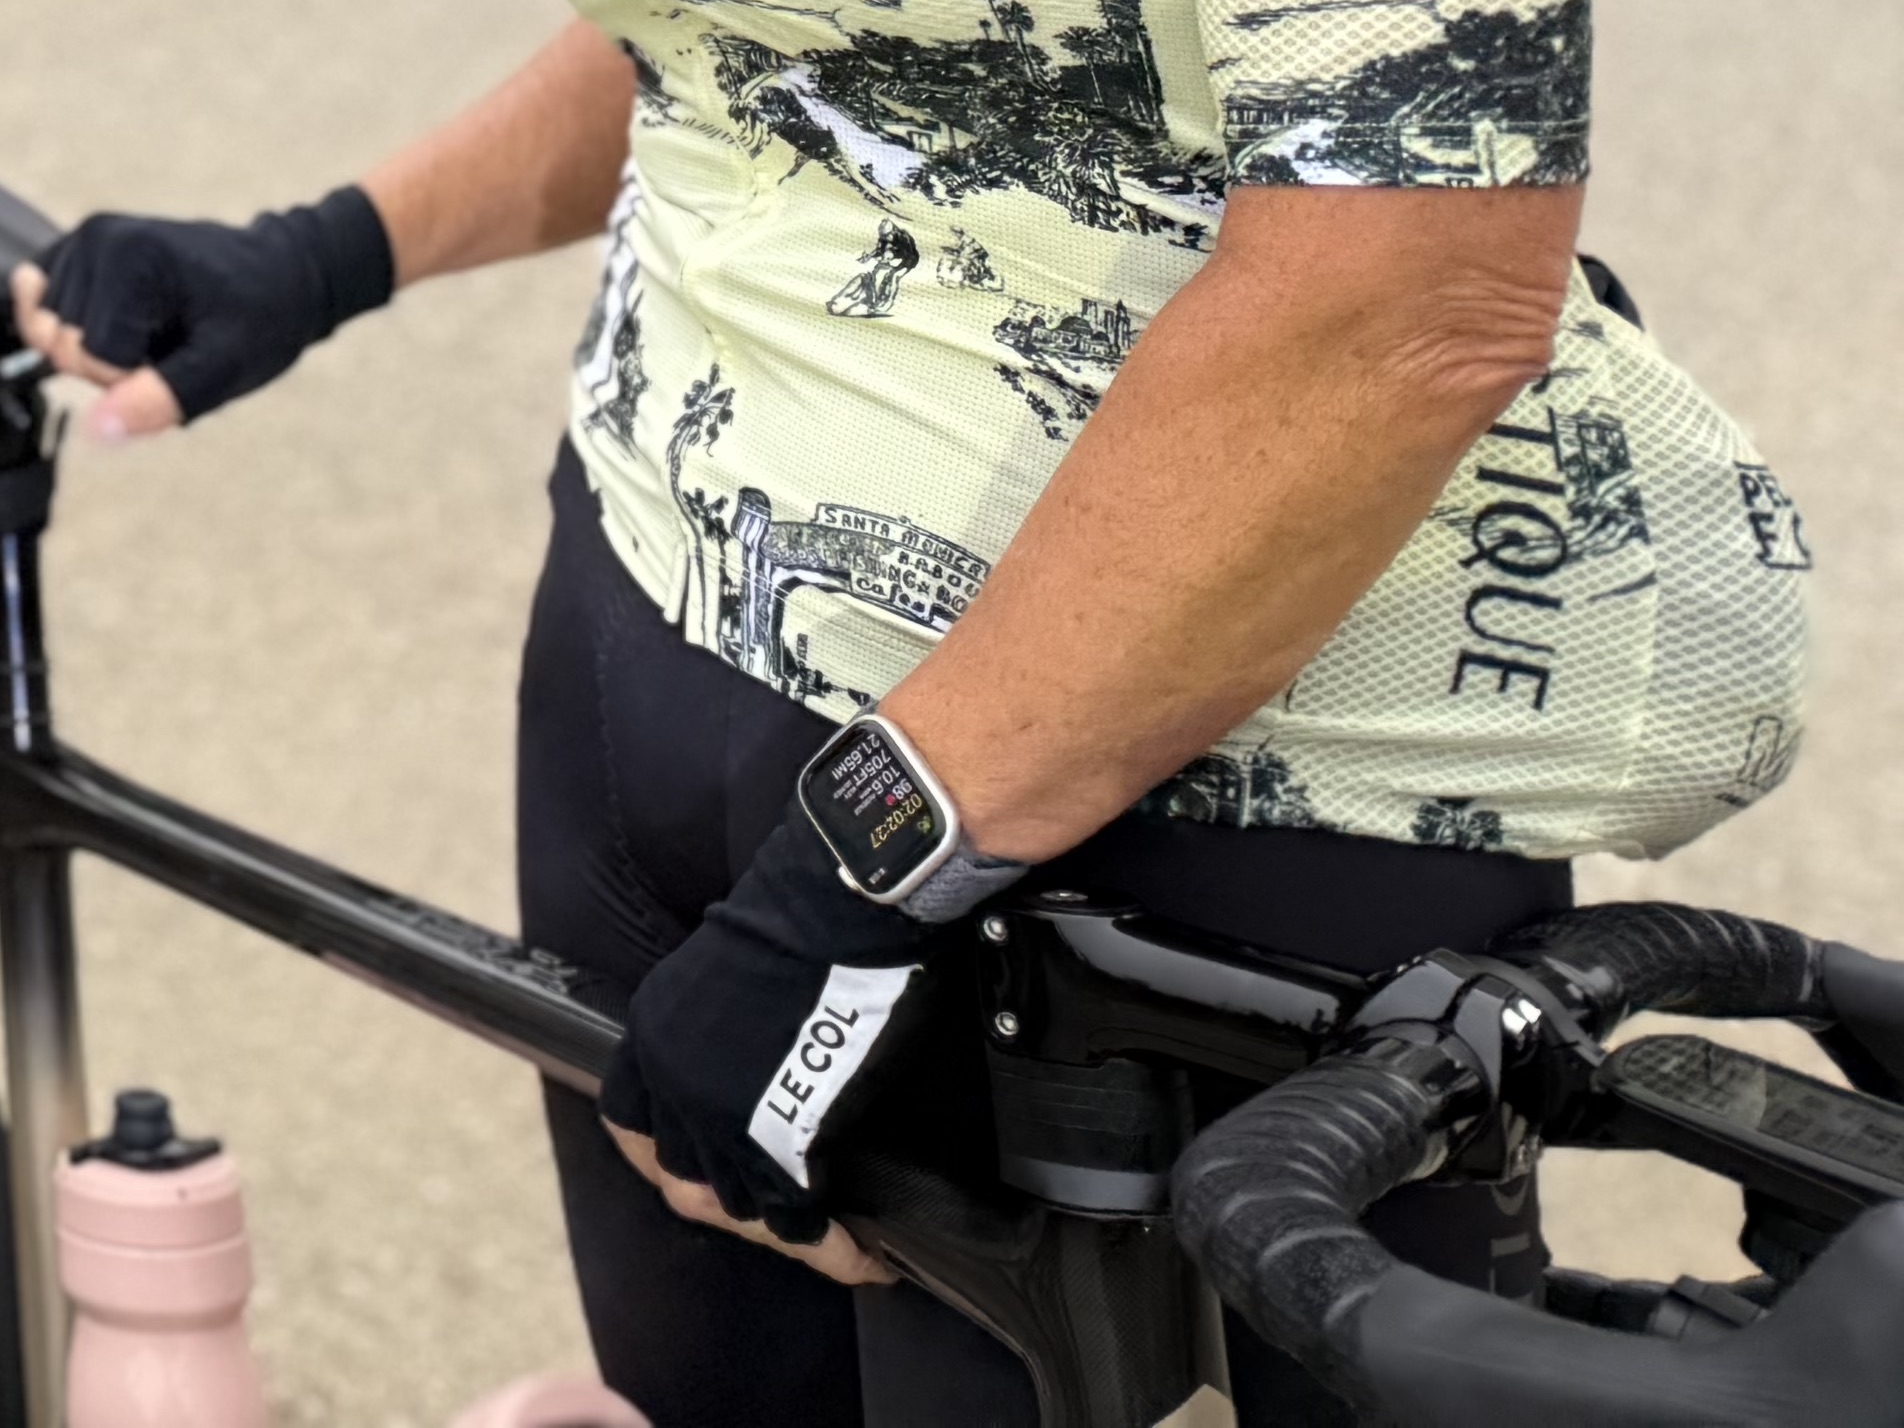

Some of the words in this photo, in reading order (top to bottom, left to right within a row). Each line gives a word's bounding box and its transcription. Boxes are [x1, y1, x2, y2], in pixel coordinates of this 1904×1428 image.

[824, 507, 891, 538] SANTA
[871, 764, 901, 795] 10.6
[891, 777, 913, 800] 98
[869, 792, 923, 850] 02:02:27
[766, 1068, 815, 1125] LE
[799, 1002, 860, 1074] COL
